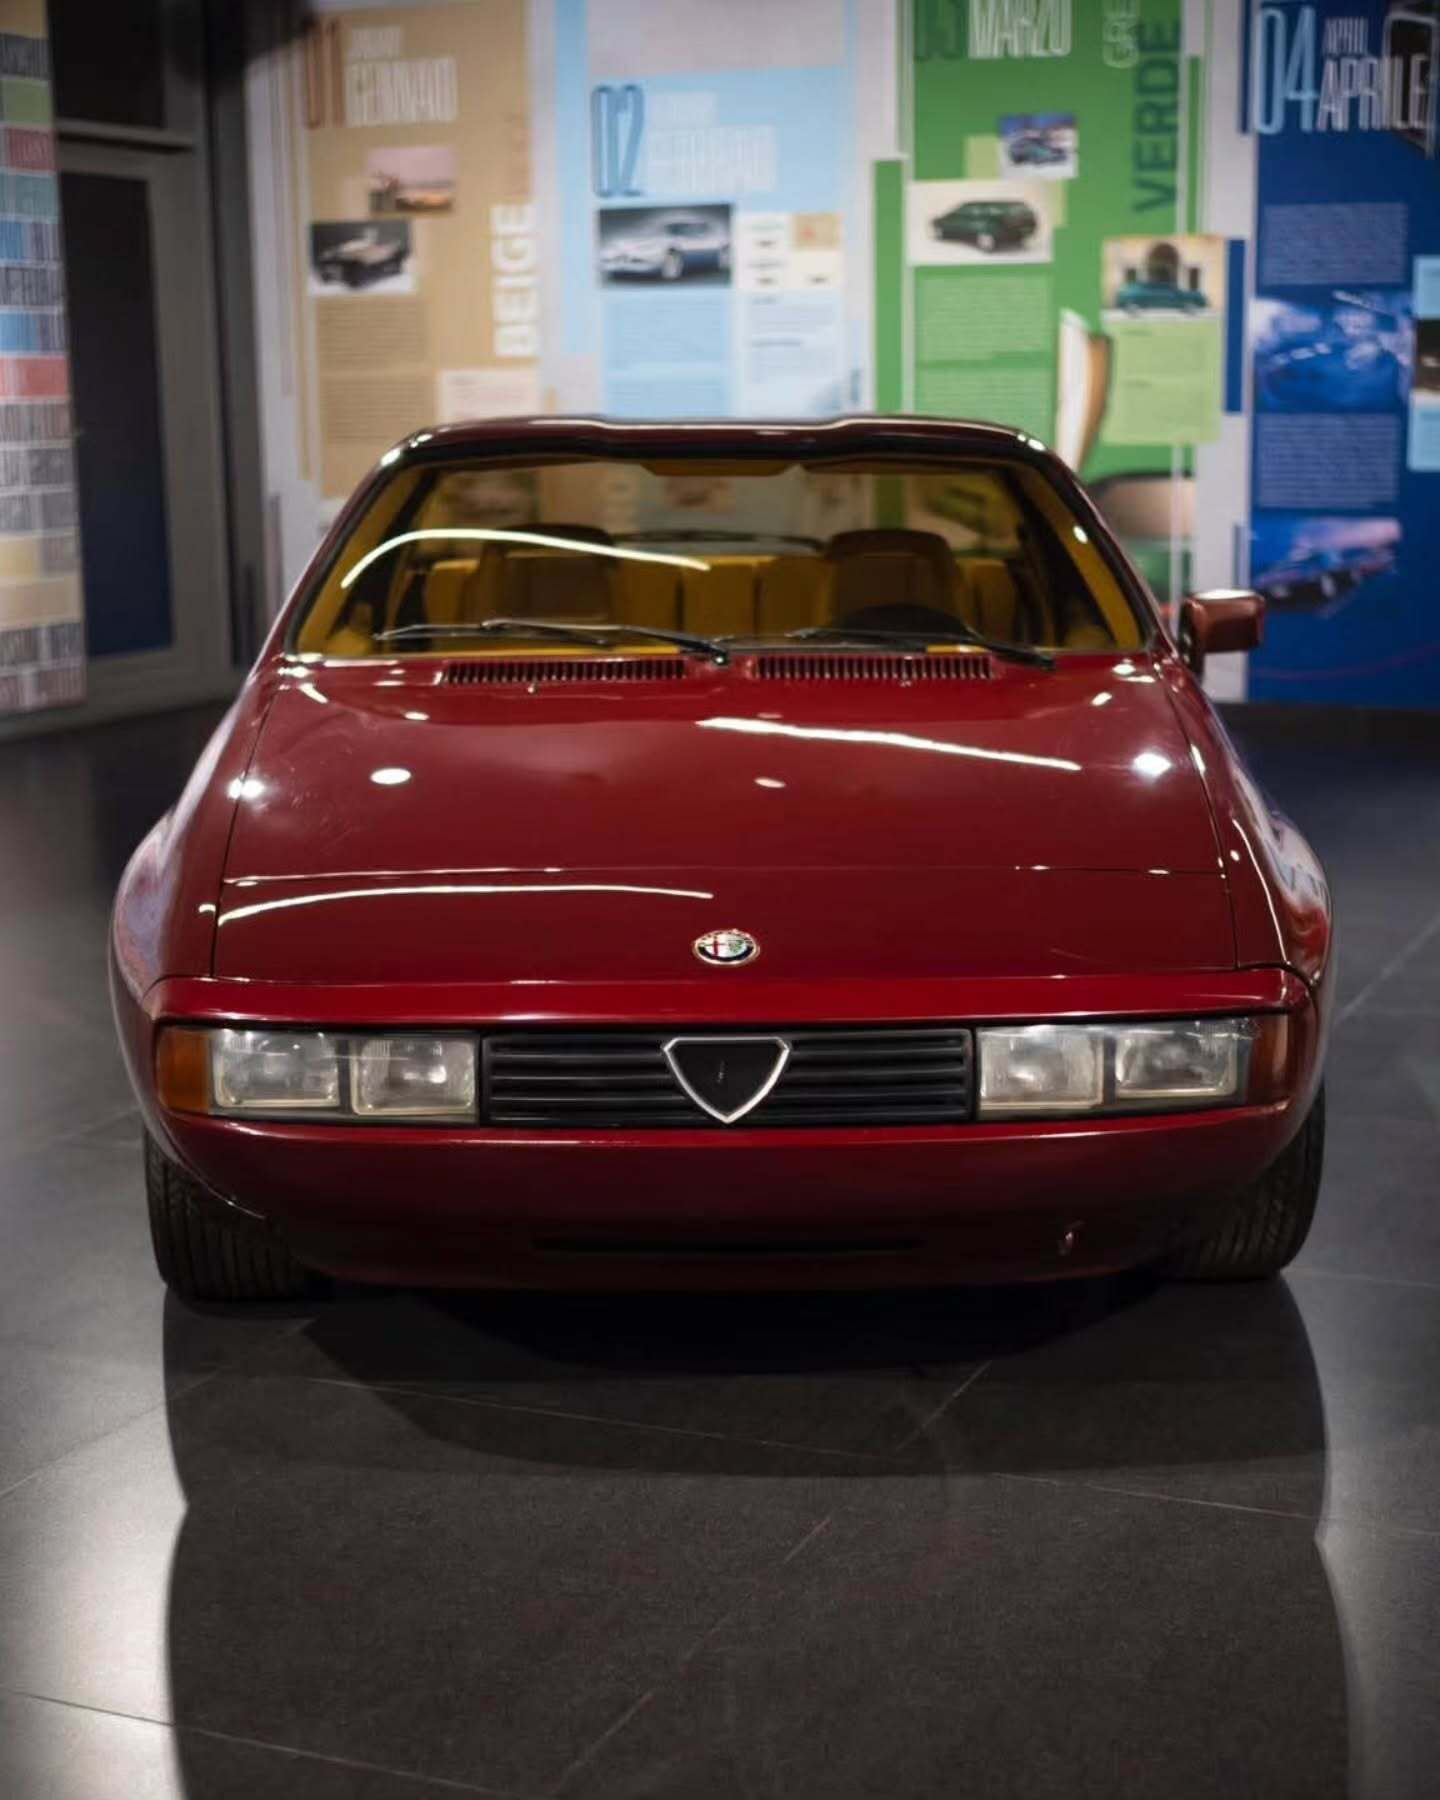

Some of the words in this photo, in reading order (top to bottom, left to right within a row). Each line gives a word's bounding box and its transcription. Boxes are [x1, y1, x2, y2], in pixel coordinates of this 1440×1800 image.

[1133, 20, 1179, 213] VERDE
[1252, 5, 1318, 134] 04
[1316, 54, 1427, 131] APRILE
[590, 84, 644, 197] 02
[490, 203, 541, 357] BEIGE
